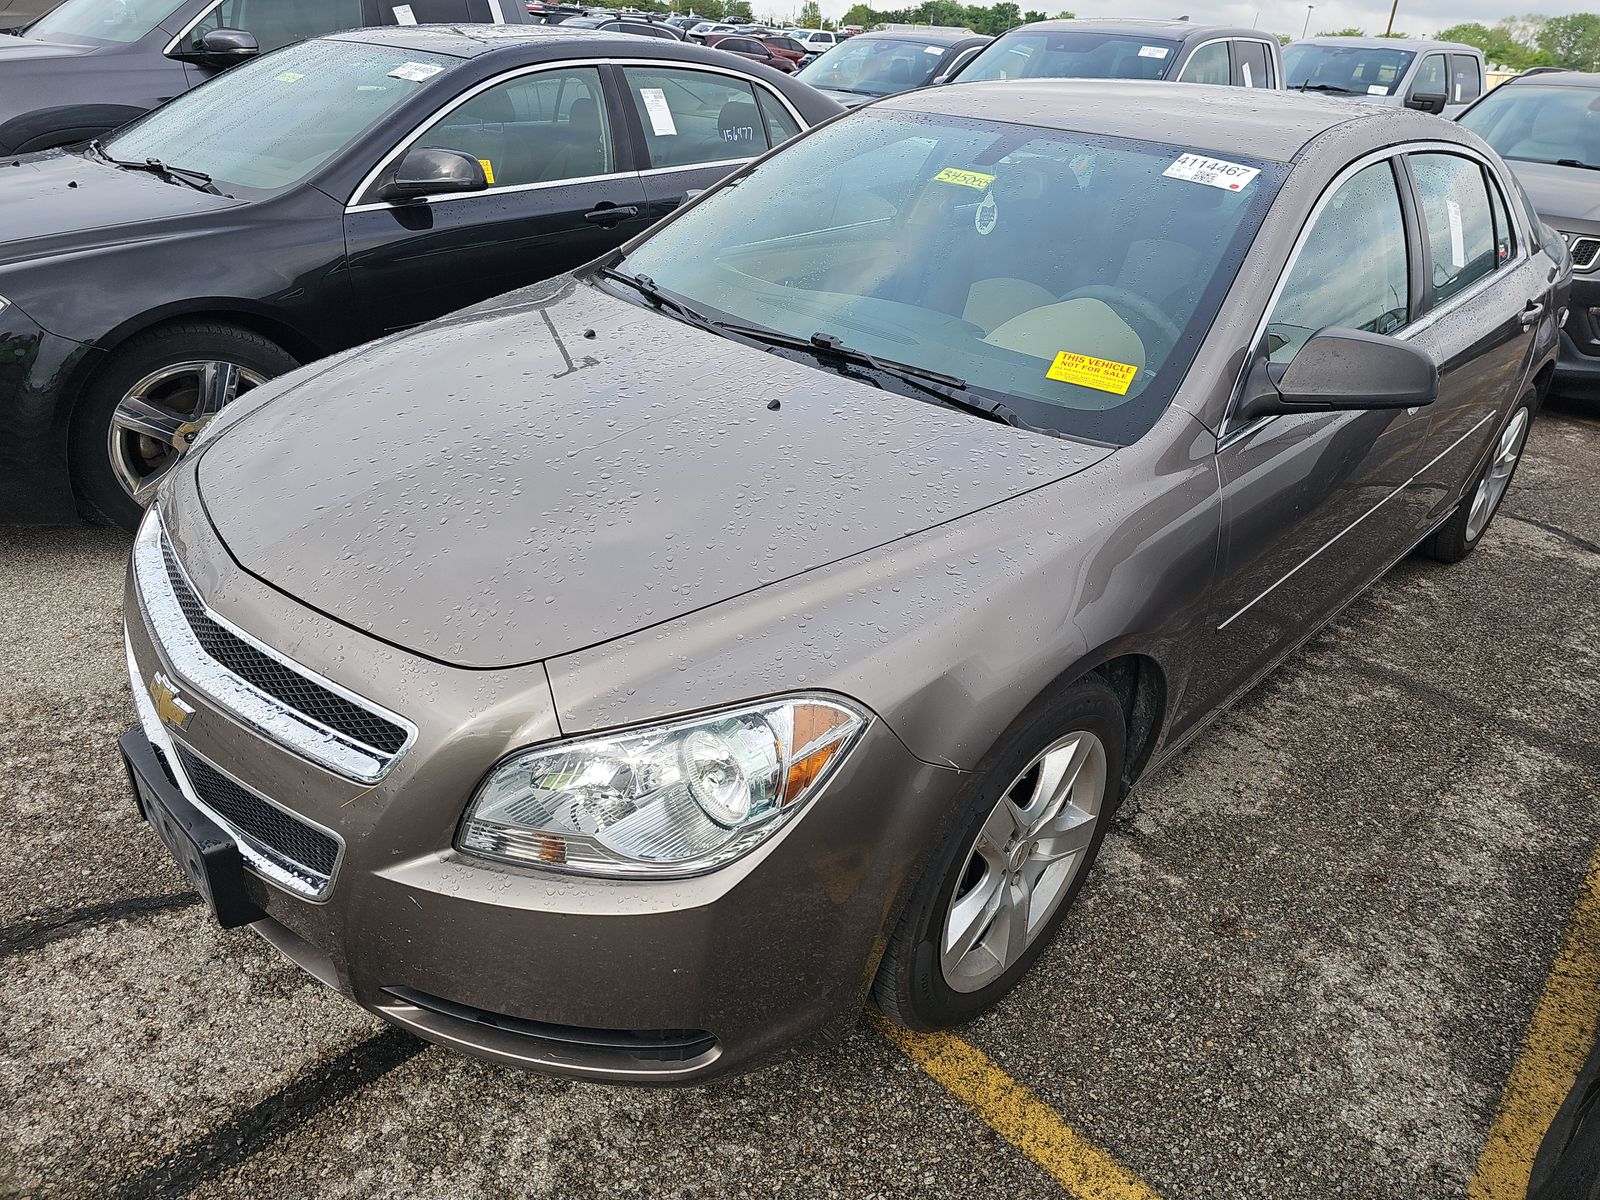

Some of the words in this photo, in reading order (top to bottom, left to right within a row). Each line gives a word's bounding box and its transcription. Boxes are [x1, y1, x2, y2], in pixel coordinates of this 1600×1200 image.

[723, 126, 753, 142] 156477
[1177, 156, 1250, 177] 4114467
[1060, 360, 1079, 369] NOT
[1081, 365, 1100, 373] FOR
[1104, 369, 1127, 380] SALE
[1062, 353, 1086, 363] THIS
[1088, 357, 1133, 374] VEHICLE
